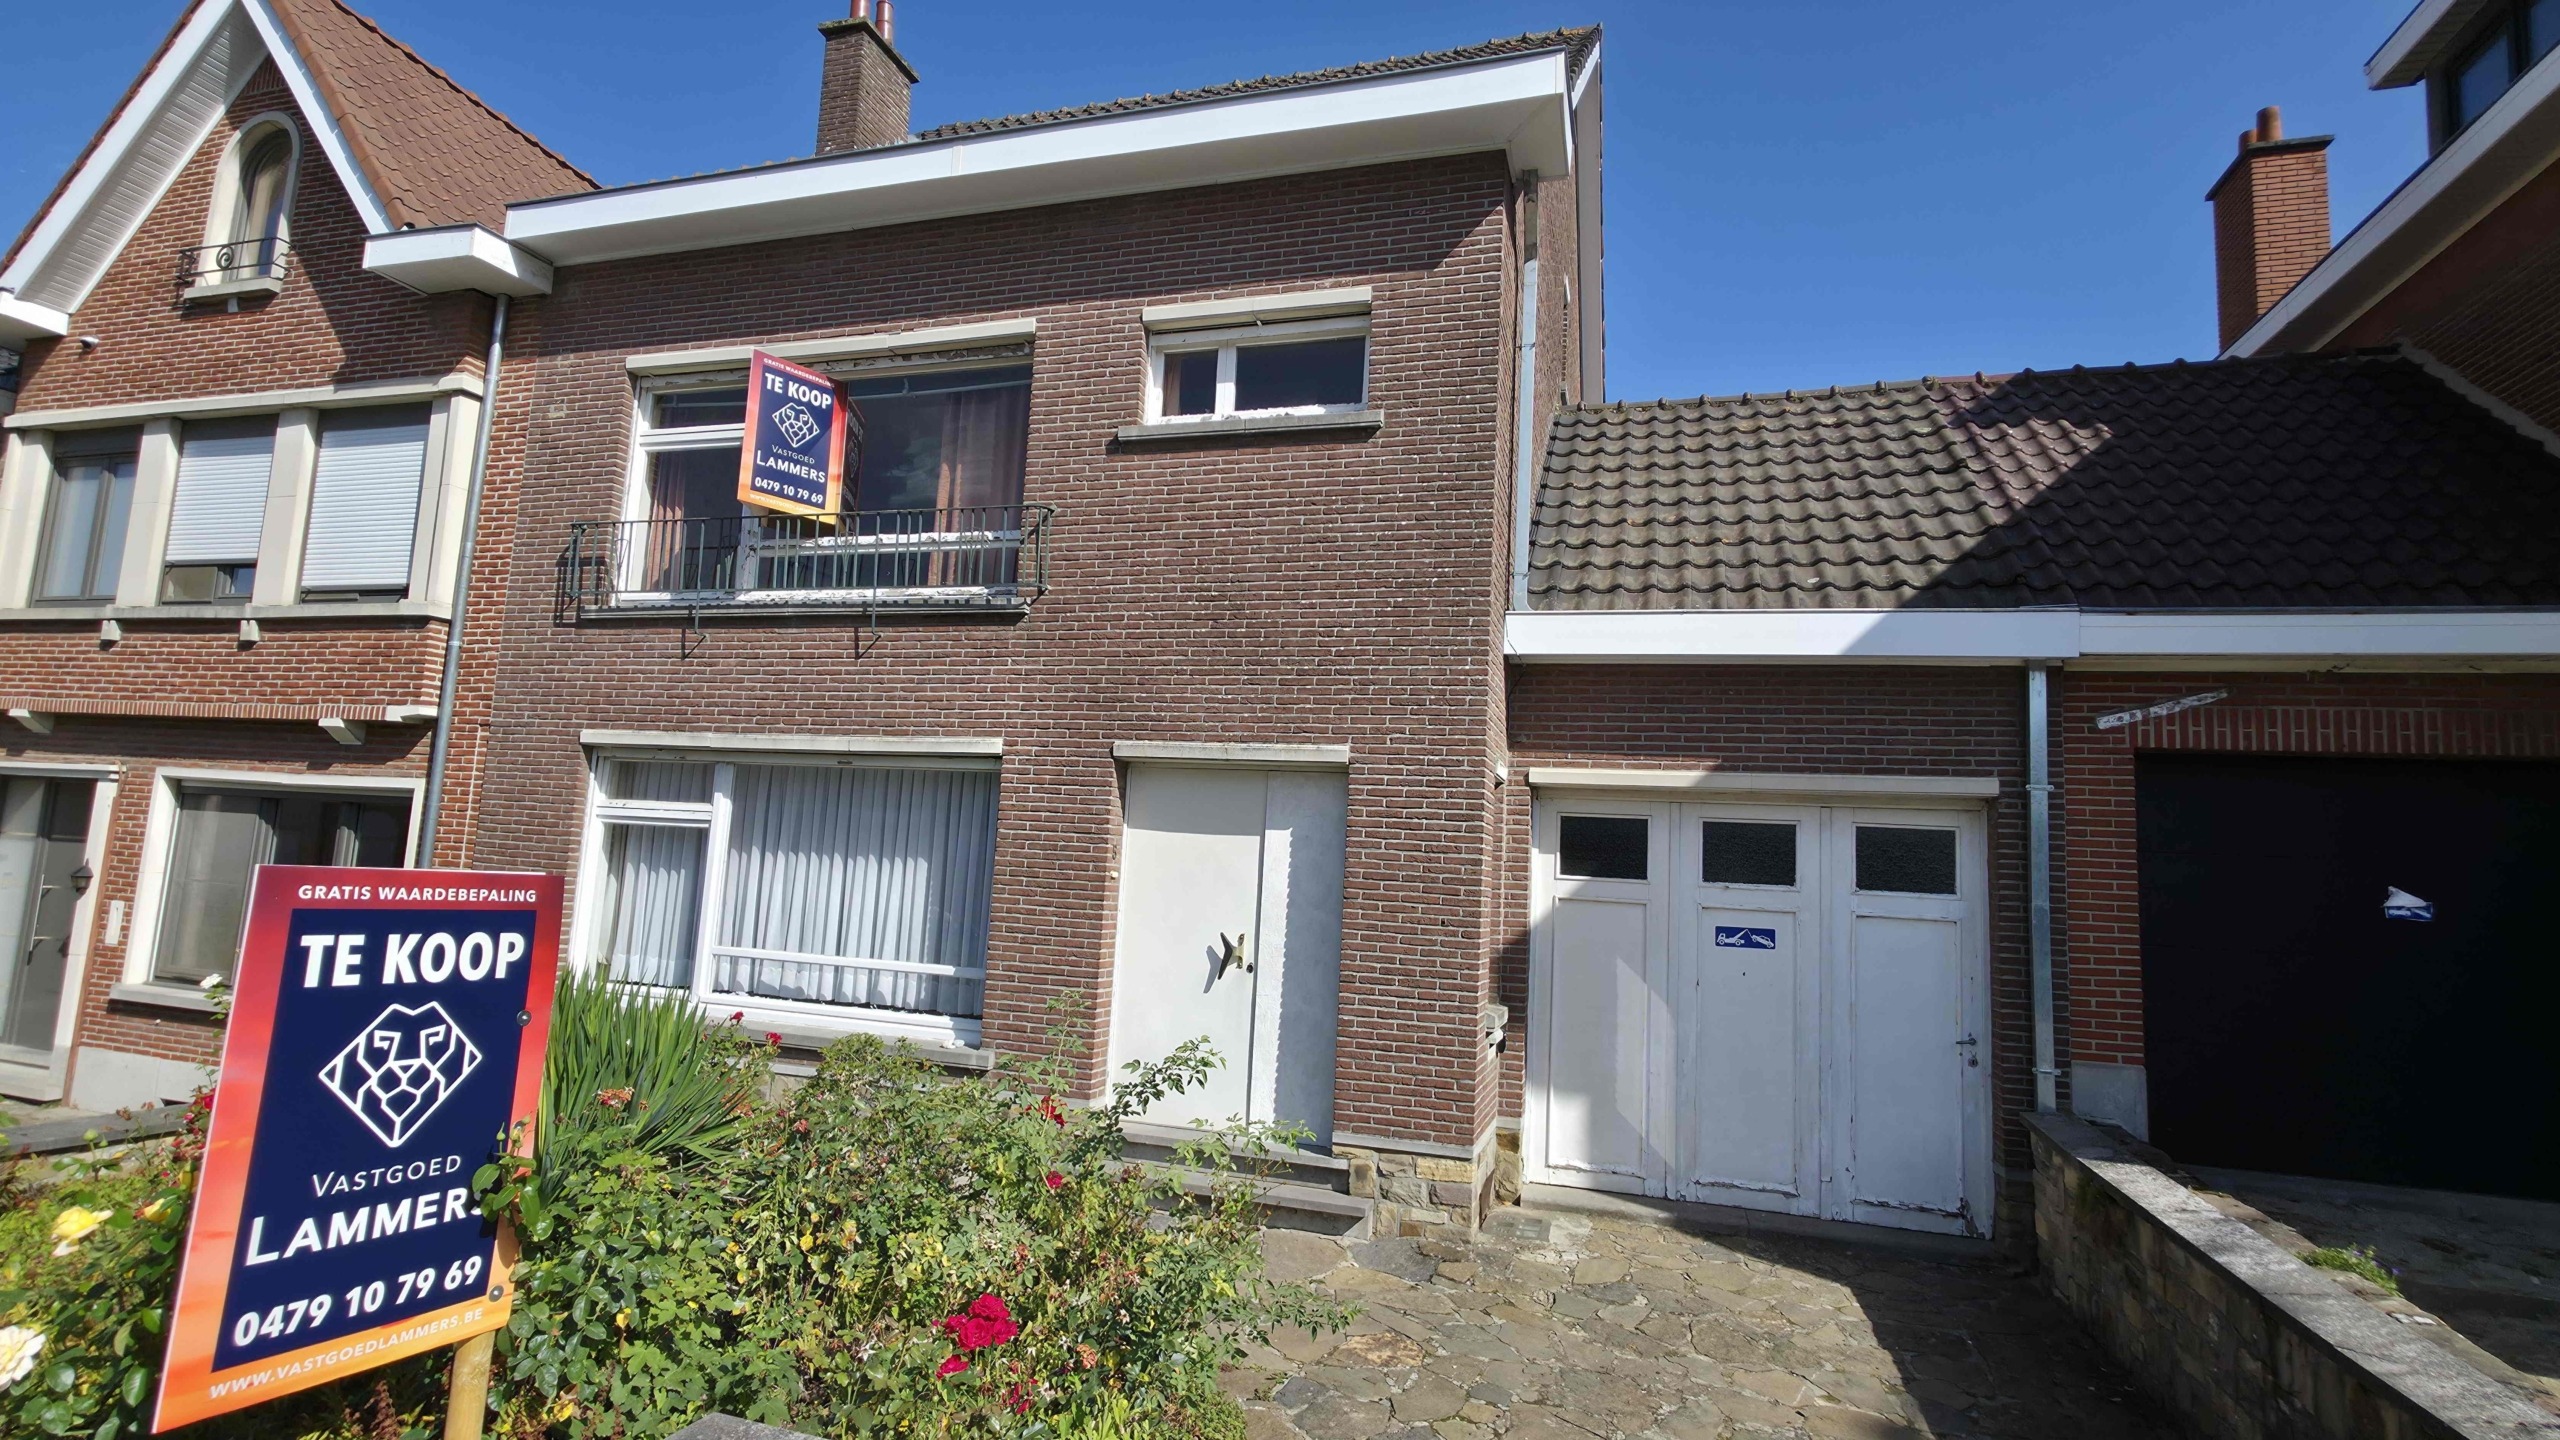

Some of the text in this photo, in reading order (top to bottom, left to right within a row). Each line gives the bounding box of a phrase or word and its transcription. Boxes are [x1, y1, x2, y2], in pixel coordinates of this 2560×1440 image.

[763, 358, 784, 370] GRATIS
[764, 372, 832, 409] TE KOOP
[756, 450, 826, 483] LAMMERS
[755, 477, 780, 491] 0479
[782, 485, 795, 497] 10
[797, 489, 810, 500] 79
[811, 493, 824, 504] 69
[298, 884, 536, 903] GRATIS WAARDEBEPALING
[300, 931, 525, 988] TE KOOP
[235, 1256, 482, 1349] 0479 10 79 69
[209, 1308, 483, 1399] WWW.VASTGOEDLAMMERS.BE
